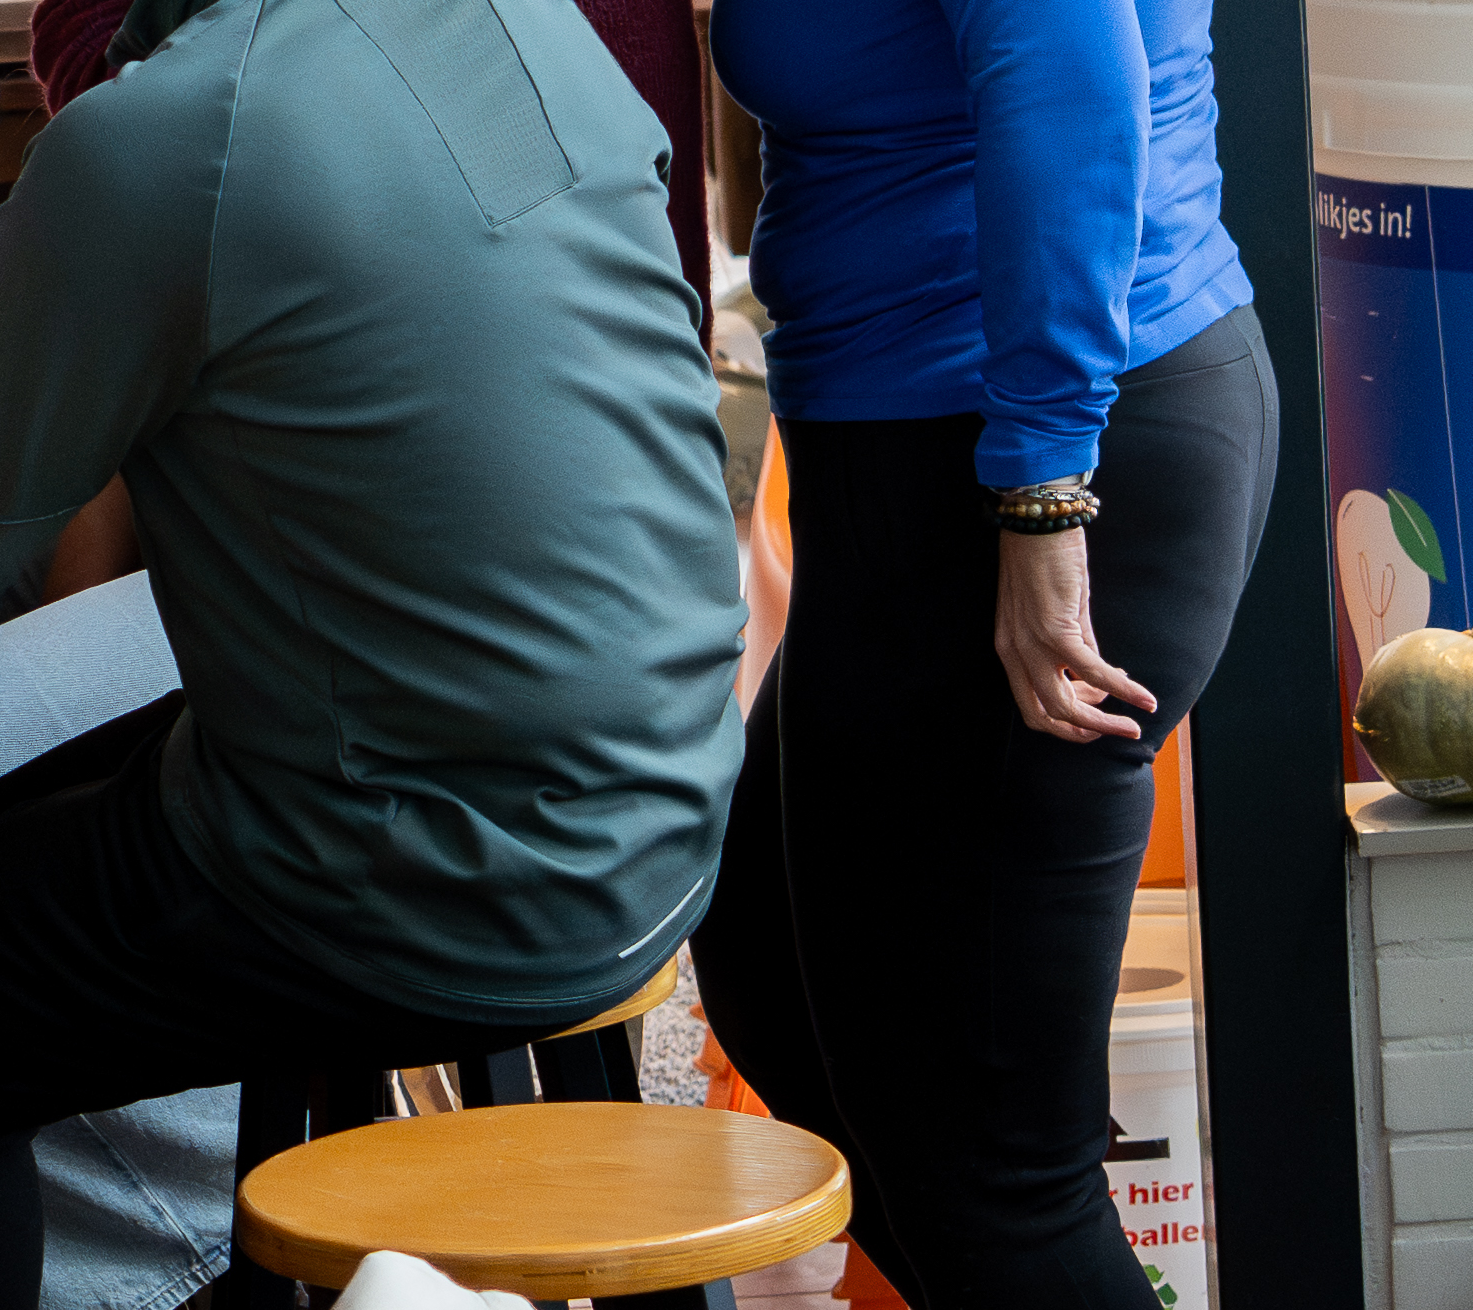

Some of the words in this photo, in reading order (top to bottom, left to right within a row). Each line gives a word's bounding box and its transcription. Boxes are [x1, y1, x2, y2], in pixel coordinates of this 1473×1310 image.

[1316, 191, 1373, 239] likjes
[1380, 203, 1412, 239] in!
[1128, 1181, 1194, 1205] hier
